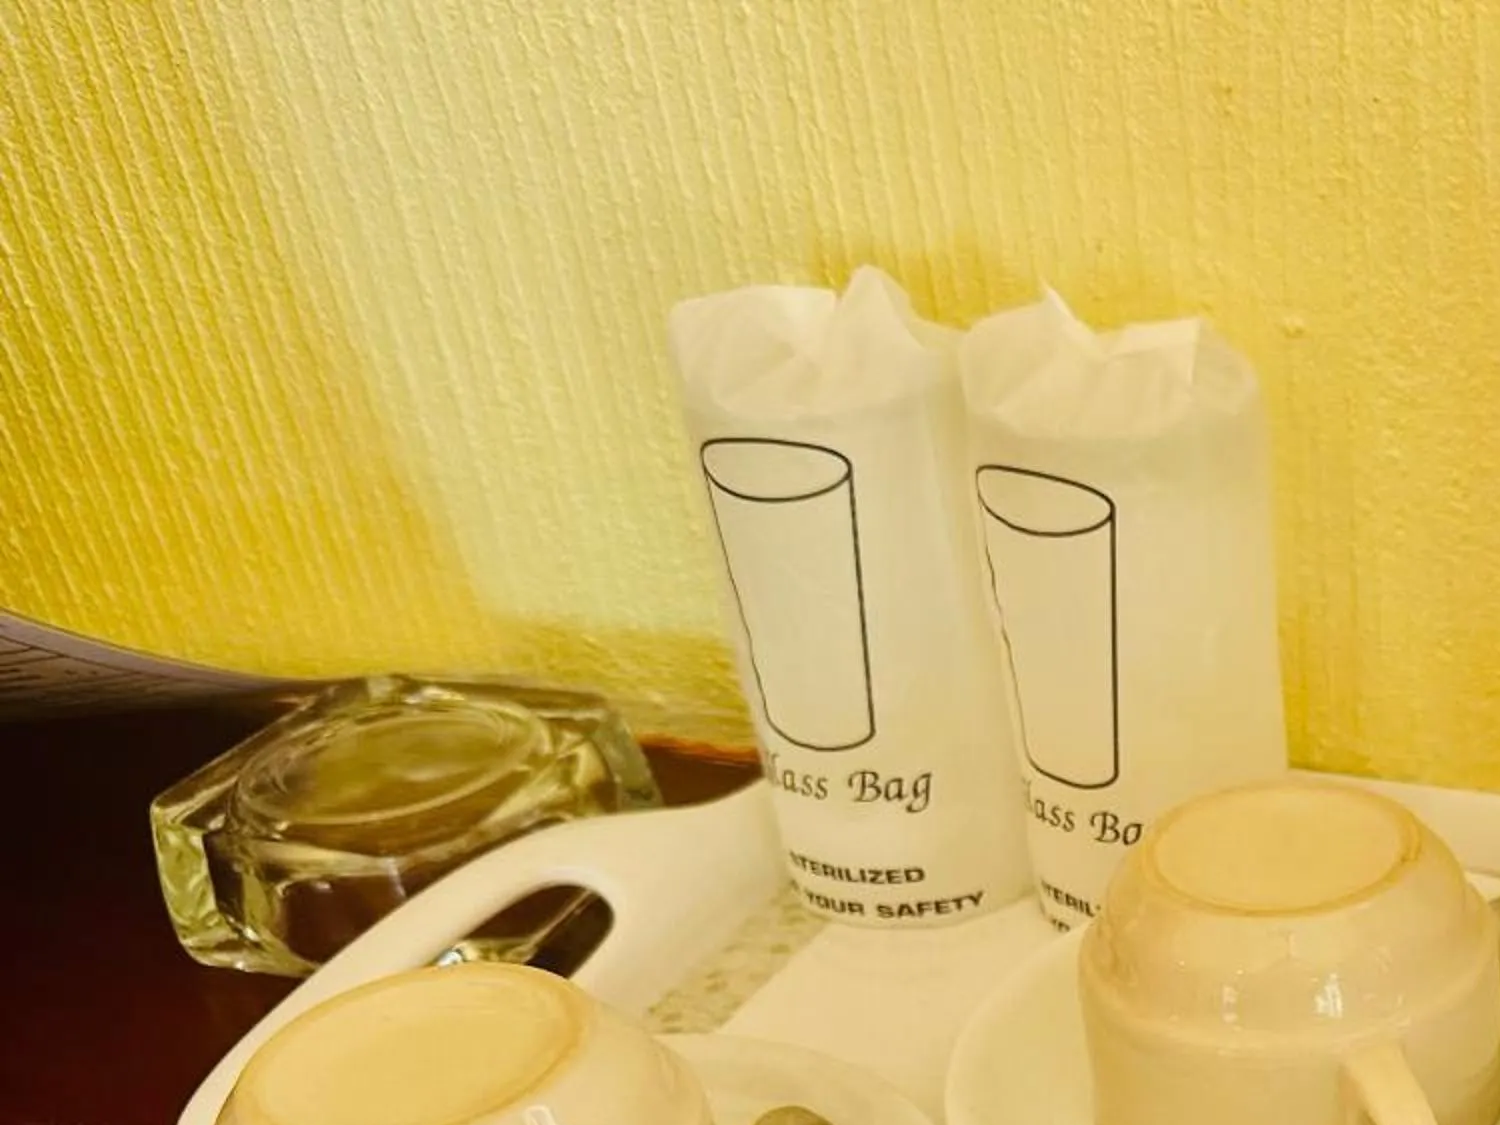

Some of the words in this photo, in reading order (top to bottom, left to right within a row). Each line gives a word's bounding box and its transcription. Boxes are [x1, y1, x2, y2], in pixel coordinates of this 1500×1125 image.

[769, 752, 829, 801] ass
[848, 769, 933, 814] Bag
[803, 888, 865, 916] YOUR
[876, 889, 985, 919] SAFETY
